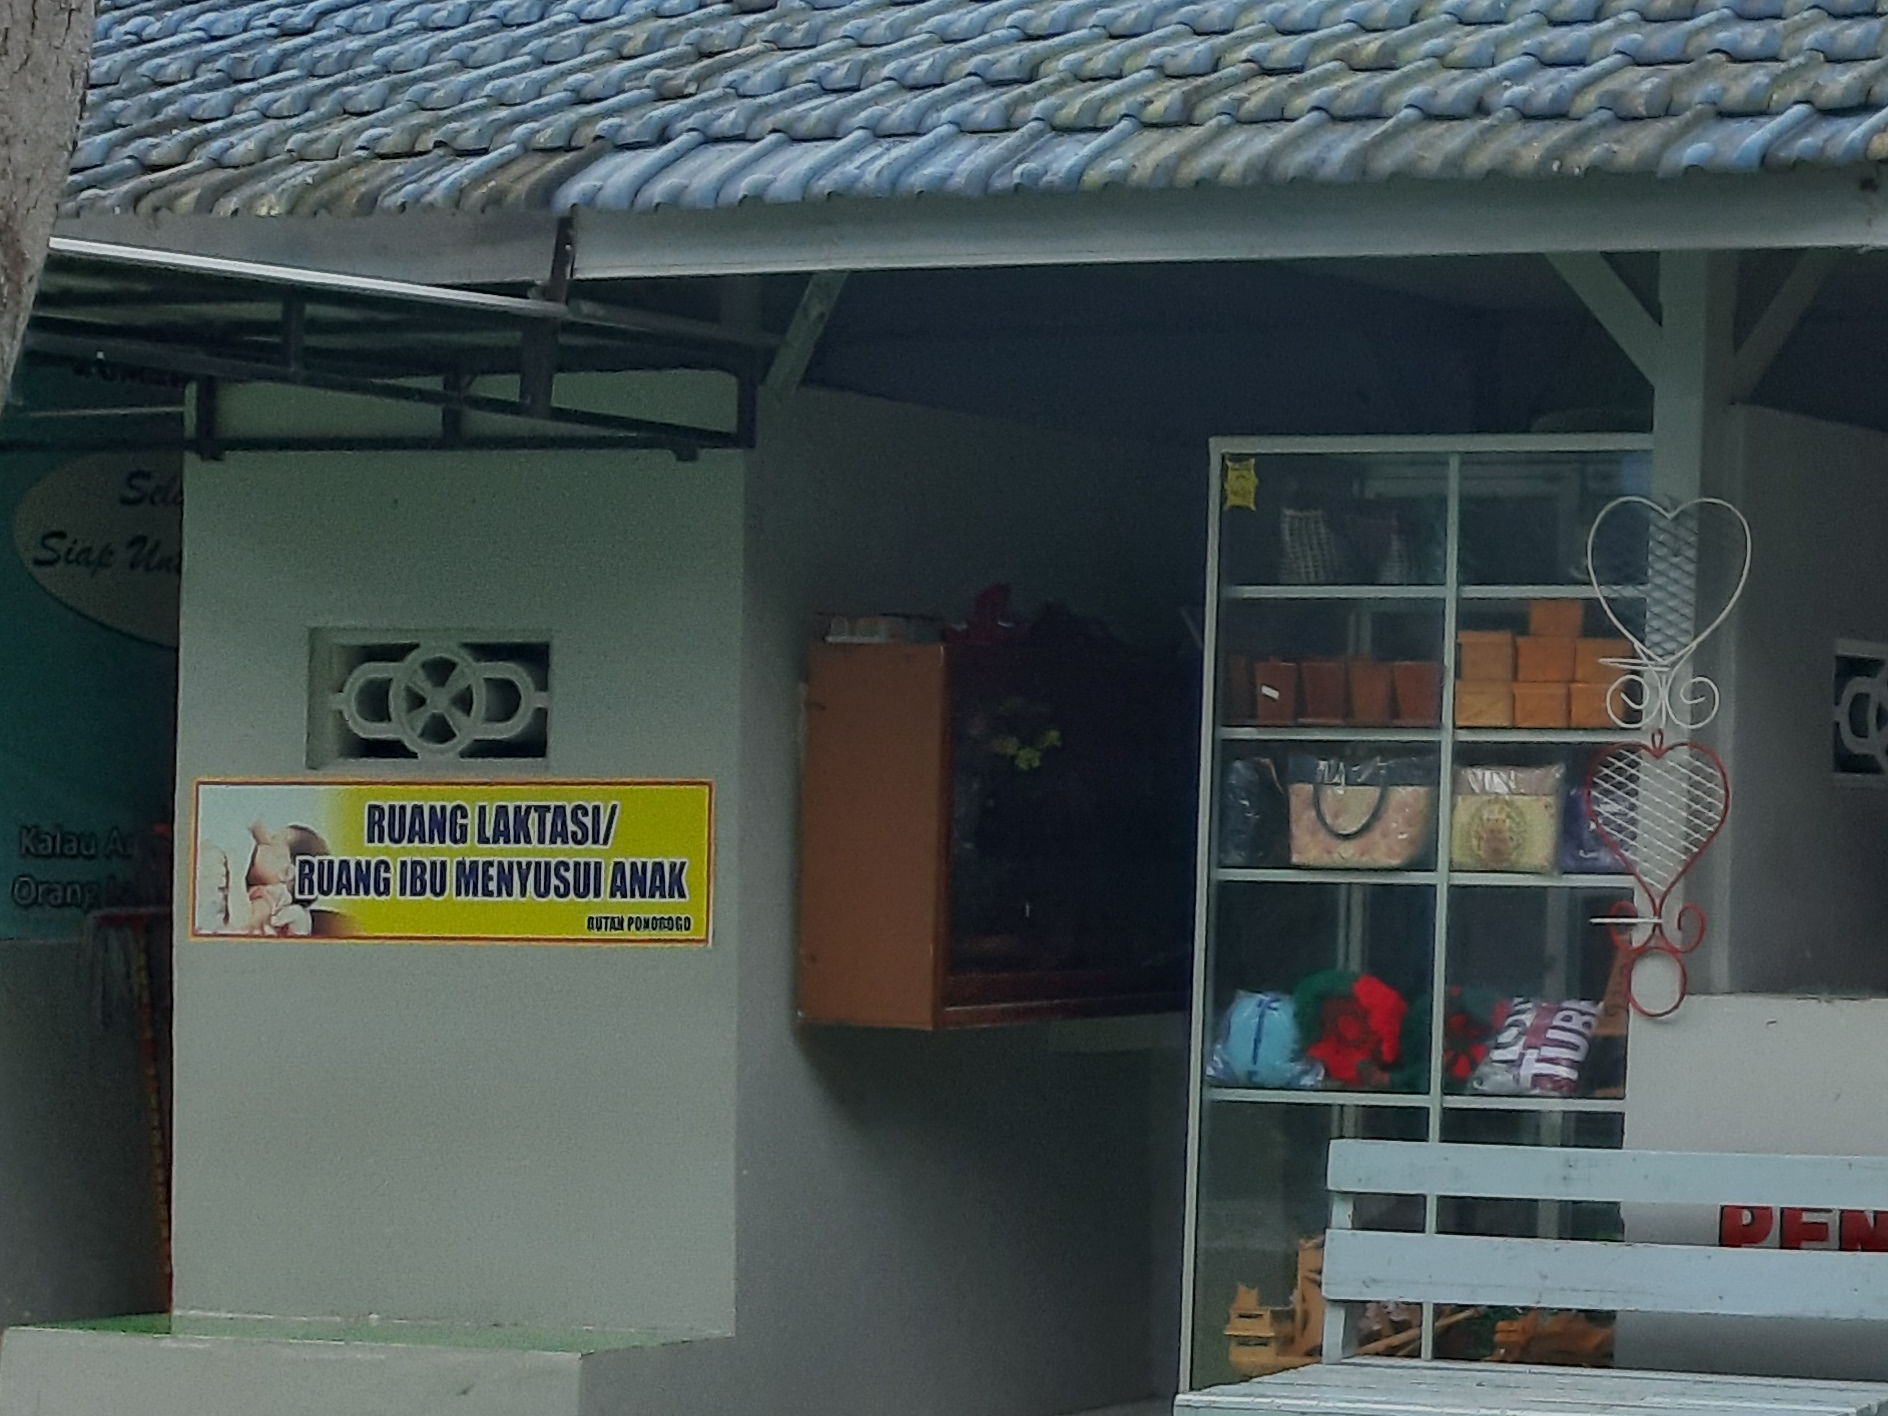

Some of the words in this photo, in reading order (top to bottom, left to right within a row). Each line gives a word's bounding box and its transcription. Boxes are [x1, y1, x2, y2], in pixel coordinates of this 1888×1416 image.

[20, 824, 97, 859] Kalau
[366, 802, 469, 846] RUANG
[477, 802, 618, 847] LAKTASI/
[296, 858, 391, 897] RUANG
[399, 858, 446, 897] IBU
[455, 858, 603, 898] MENYUSUI
[608, 860, 688, 900] ANAK
